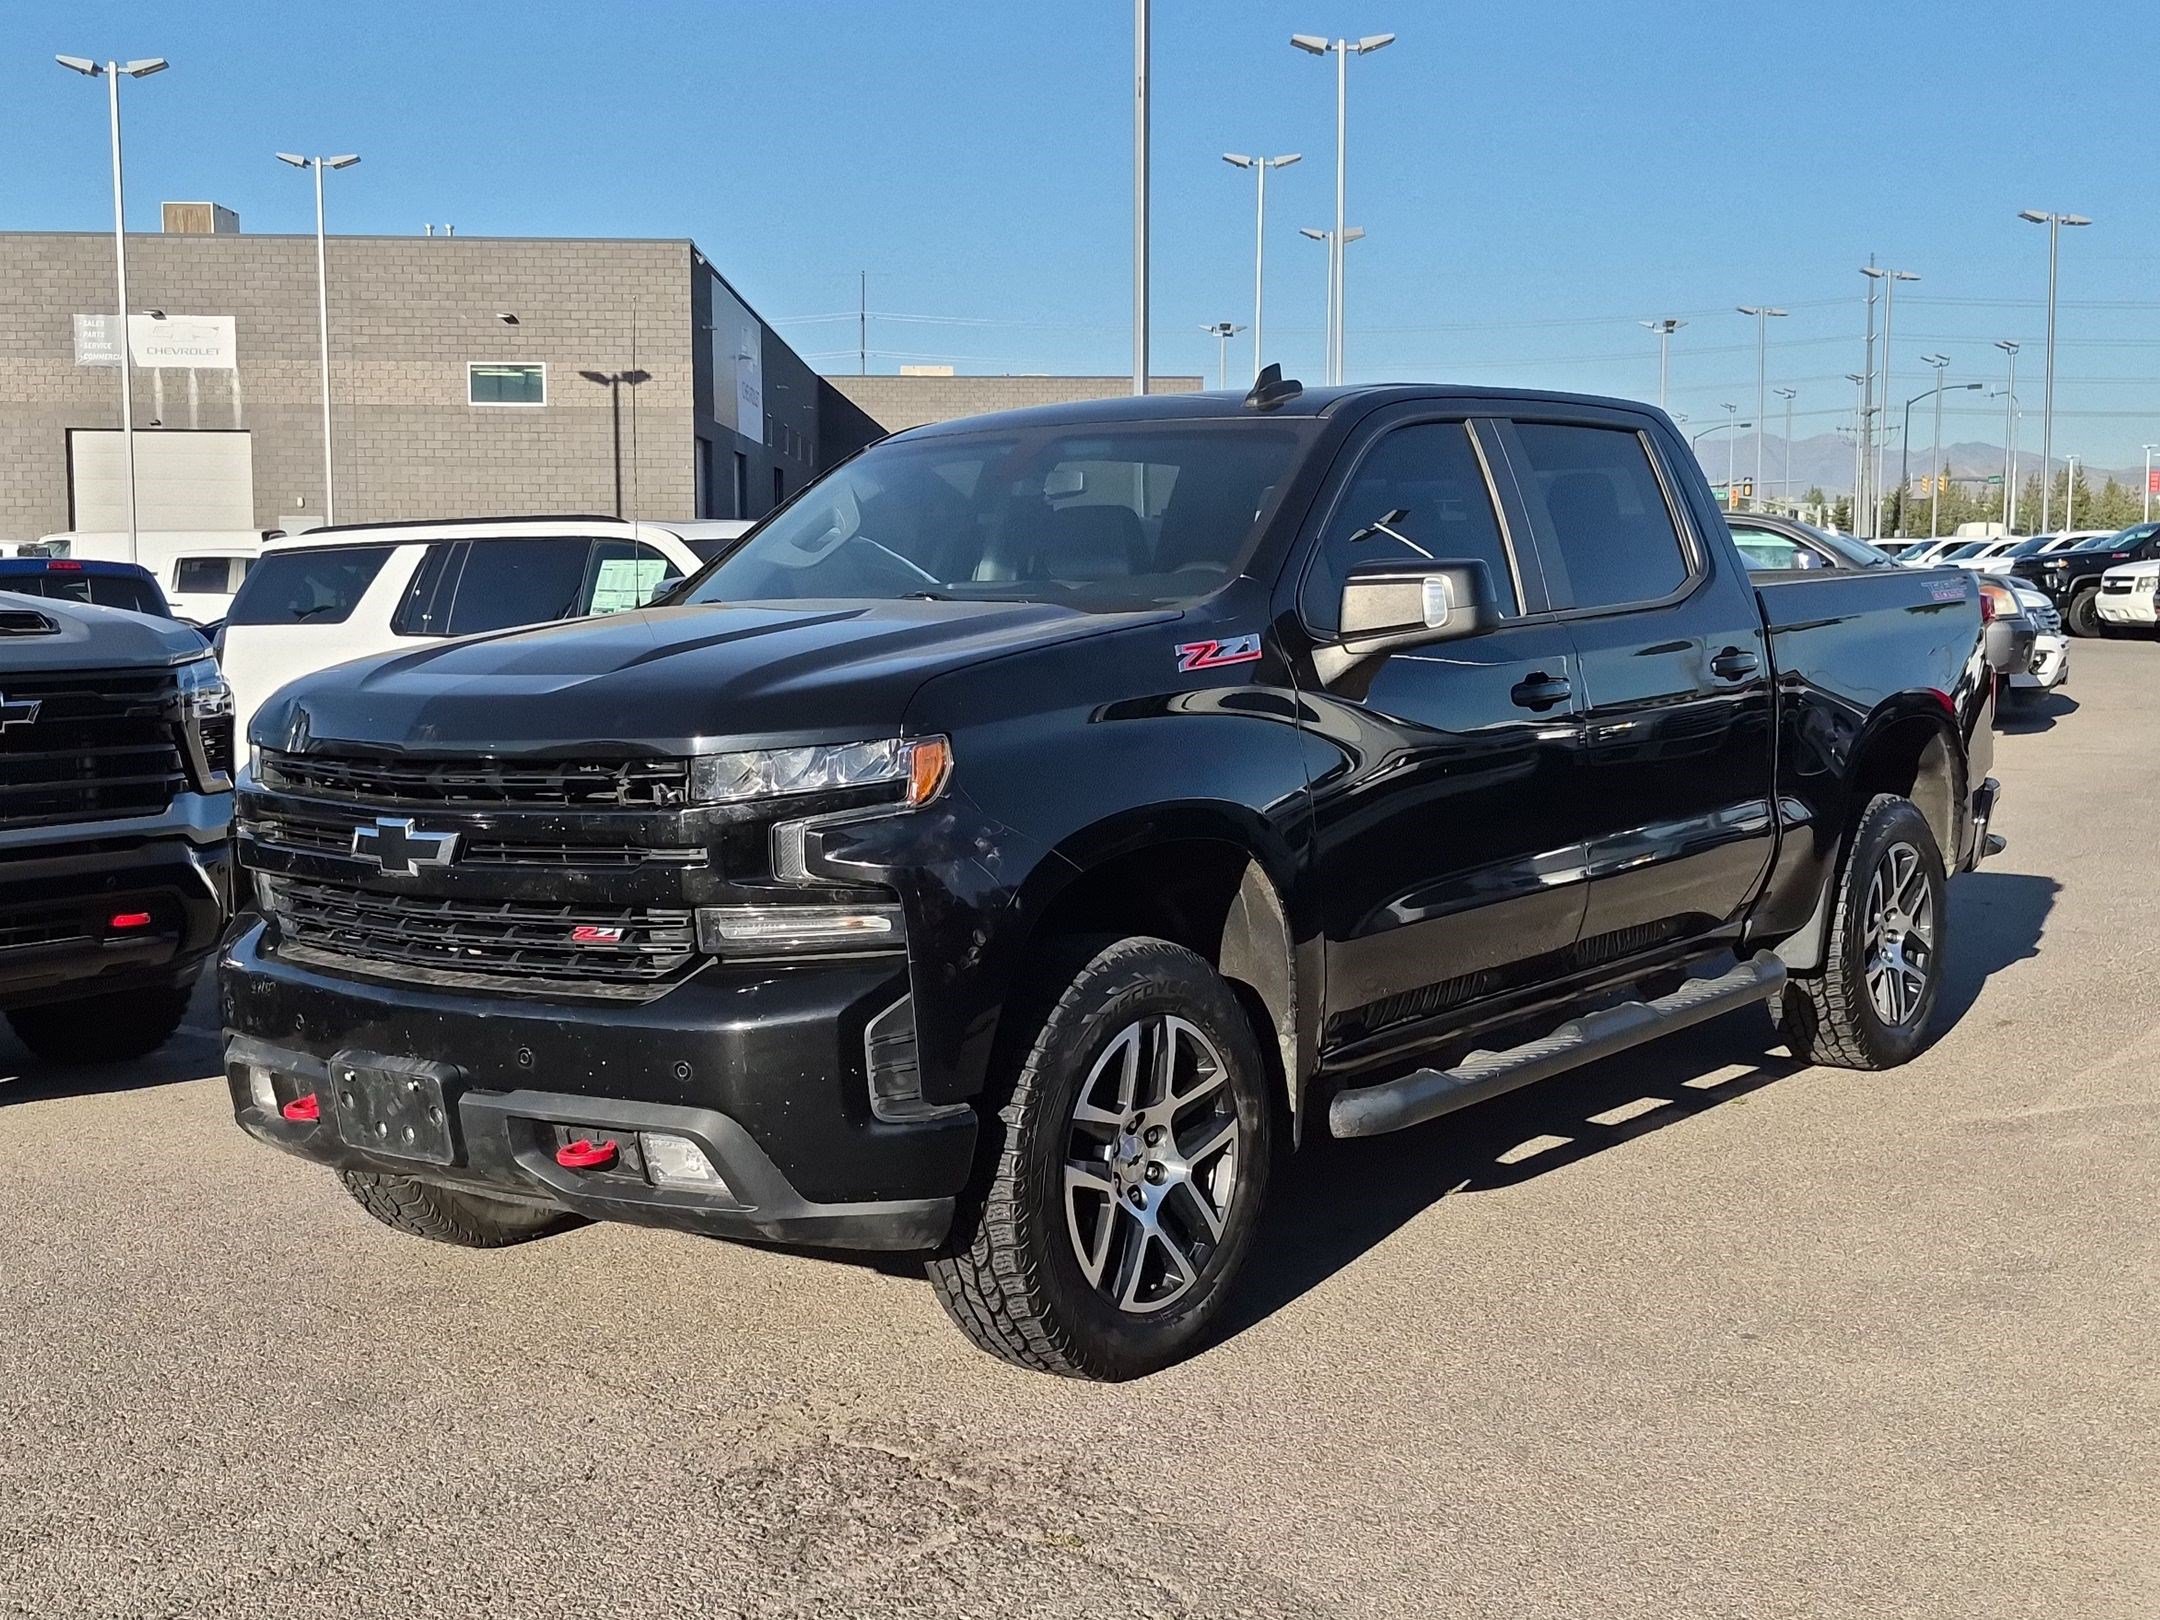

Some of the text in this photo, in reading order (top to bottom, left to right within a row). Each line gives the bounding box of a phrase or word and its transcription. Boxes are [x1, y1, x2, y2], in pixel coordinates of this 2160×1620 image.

[83, 352, 123, 361] COMMERCIA
[146, 346, 220, 356] CHEVROLET
[1174, 632, 1263, 673] Z71
[572, 926, 625, 942] Z71
